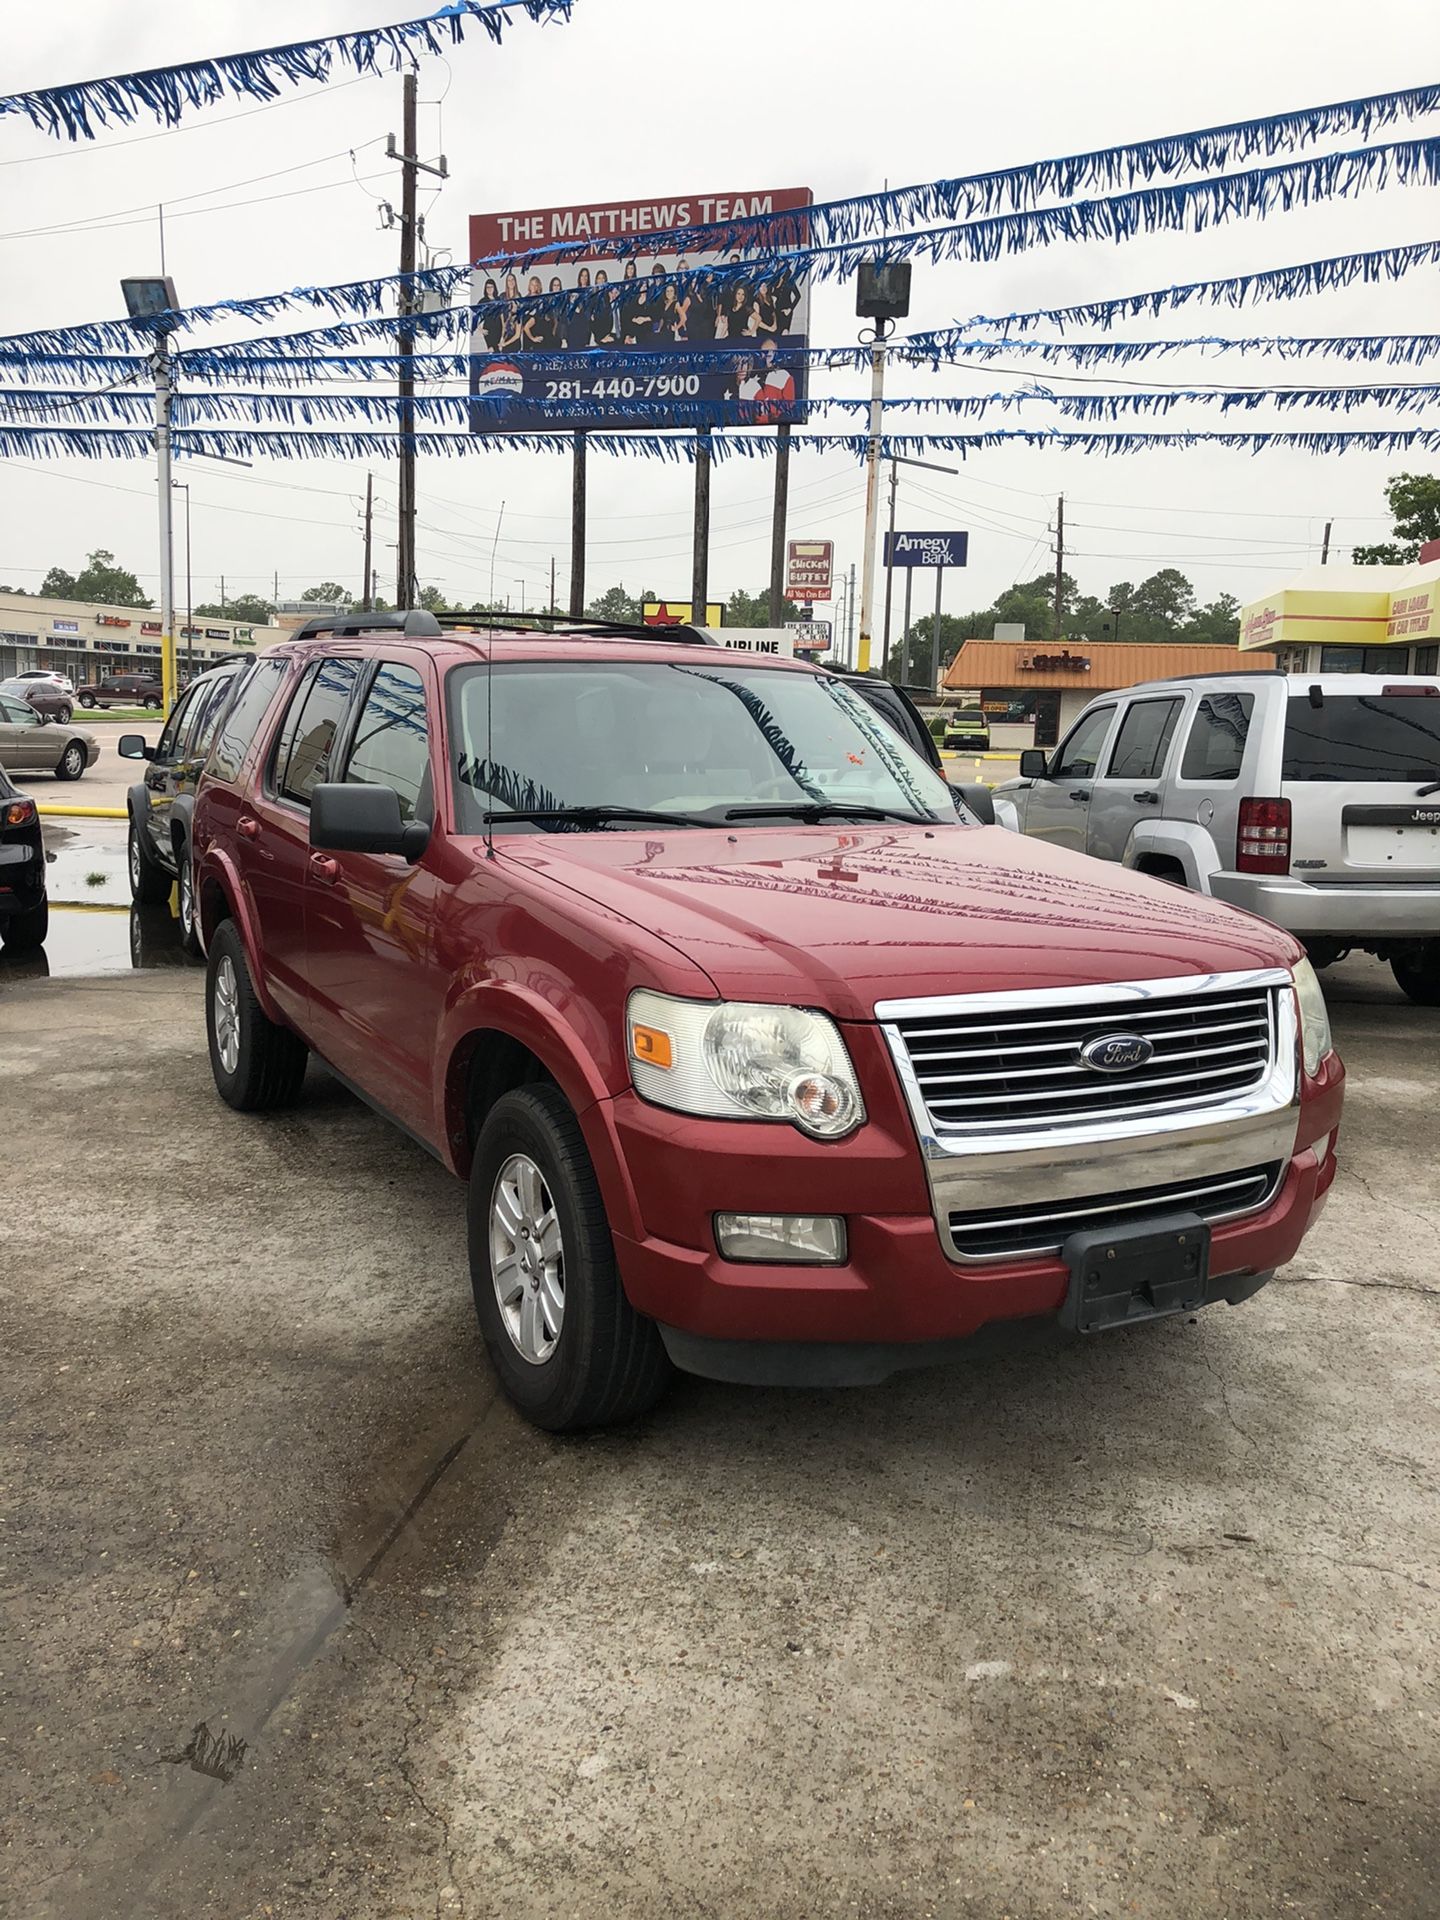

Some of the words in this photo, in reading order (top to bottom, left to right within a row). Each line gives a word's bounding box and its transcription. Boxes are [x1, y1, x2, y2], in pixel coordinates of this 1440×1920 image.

[497, 216, 545, 242] THE
[551, 202, 691, 238] MATTHEWS
[698, 195, 773, 225] TEAM
[546, 374, 700, 400] 281-440-7900
[895, 534, 950, 553] Amegy
[789, 558, 830, 570] CHICKEN
[922, 550, 954, 564] Bank
[790, 572, 829, 583] BUFFET
[794, 589, 805, 598] You
[806, 589, 818, 598] Can
[725, 640, 779, 655] AIRLINE
[1411, 809, 1440, 822] Jeep
[1103, 1042, 1142, 1064] Ford
